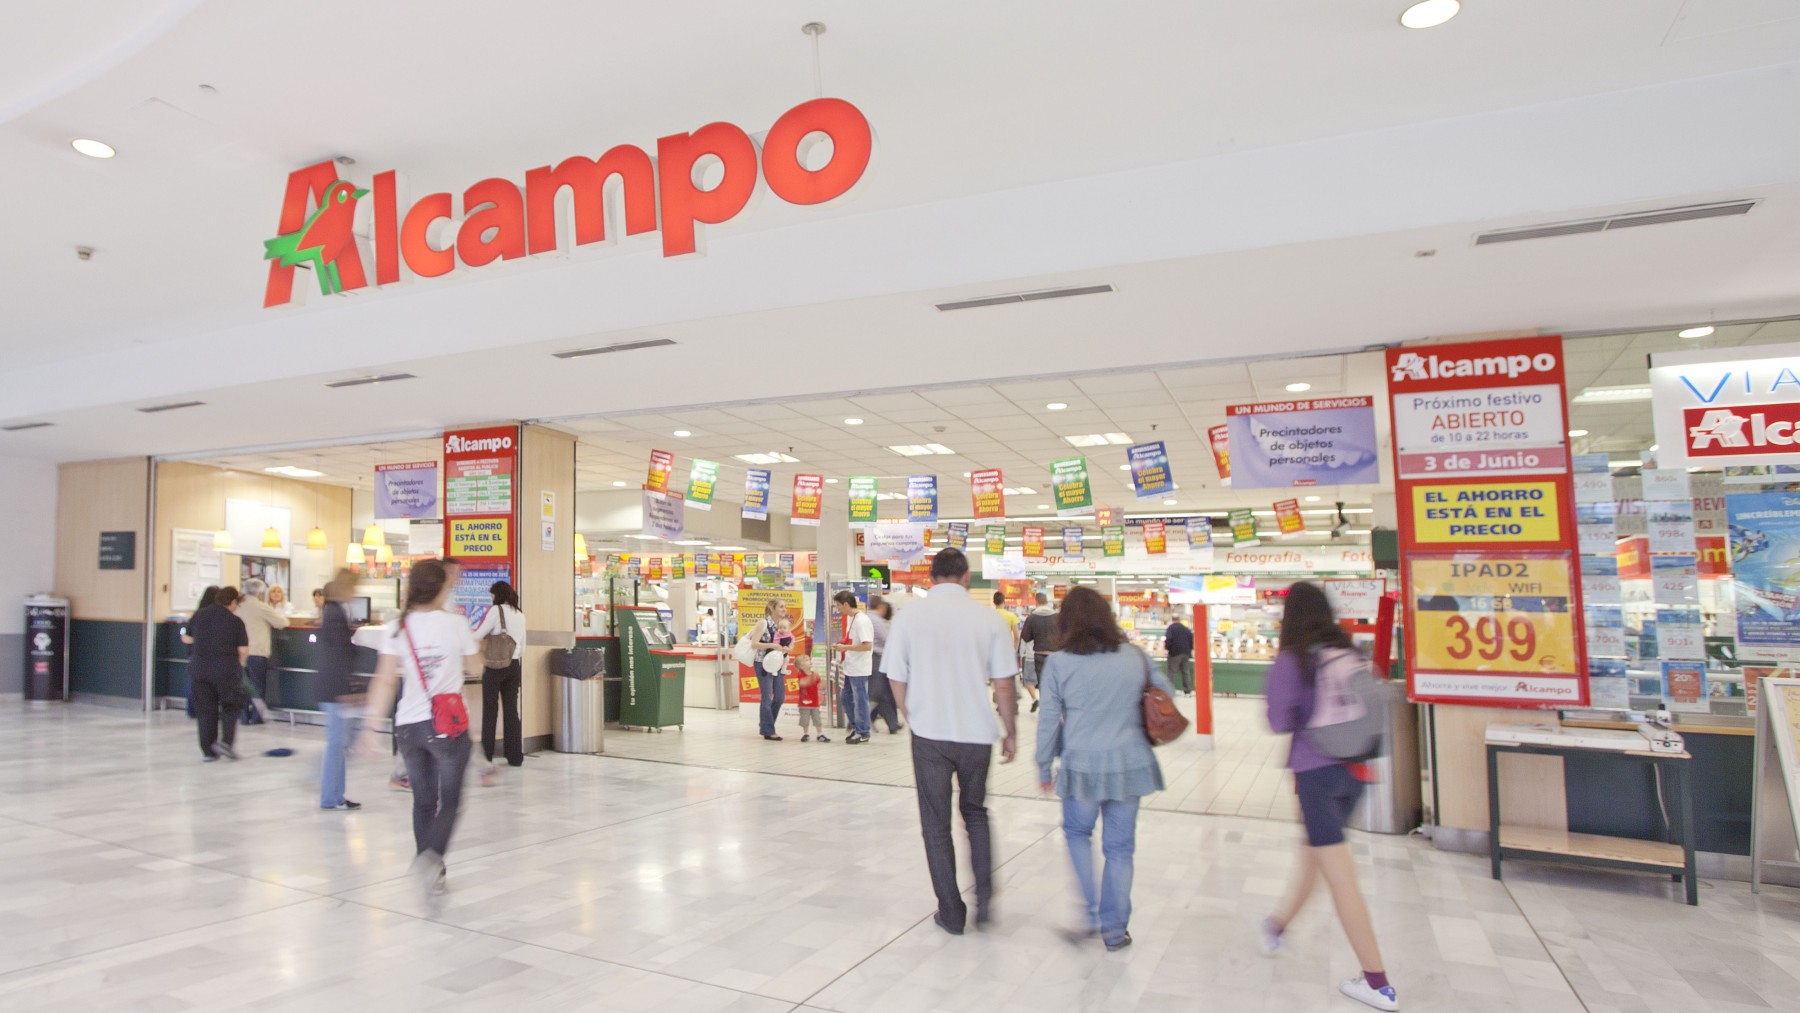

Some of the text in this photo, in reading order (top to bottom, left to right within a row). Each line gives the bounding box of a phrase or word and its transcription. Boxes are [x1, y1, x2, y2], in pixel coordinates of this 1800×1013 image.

[263, 97, 873, 308] Alcampo
[1391, 352, 1557, 382] Alcampo
[1680, 367, 1800, 403] VIA
[1235, 397, 1368, 415] UN MUNDO DE SERVICIOS
[1413, 393, 1542, 411] Próximo festivo
[1431, 410, 1525, 431] ABIERTO
[1259, 424, 1343, 438] Precintadores
[1689, 408, 1800, 449] Alc
[1431, 430, 1529, 443] de 10 a 22 horas
[446, 435, 511, 454] Alcampo
[1270, 440, 1334, 453] de objetos
[1269, 452, 1336, 468] personales
[1424, 451, 1540, 471] 3 de Junio
[1425, 488, 1544, 503] EL AHORRO
[1426, 505, 1545, 519] ESTÁ EN EL
[455, 532, 476, 542] ESTÁ
[1449, 523, 1523, 536] PRECIO
[464, 544, 492, 552] PRECIO
[1451, 563, 1530, 578] IPAD2
[1508, 582, 1542, 594] WIFI
[1445, 615, 1557, 670] 399 €
[1515, 681, 1572, 694] Alcampo
